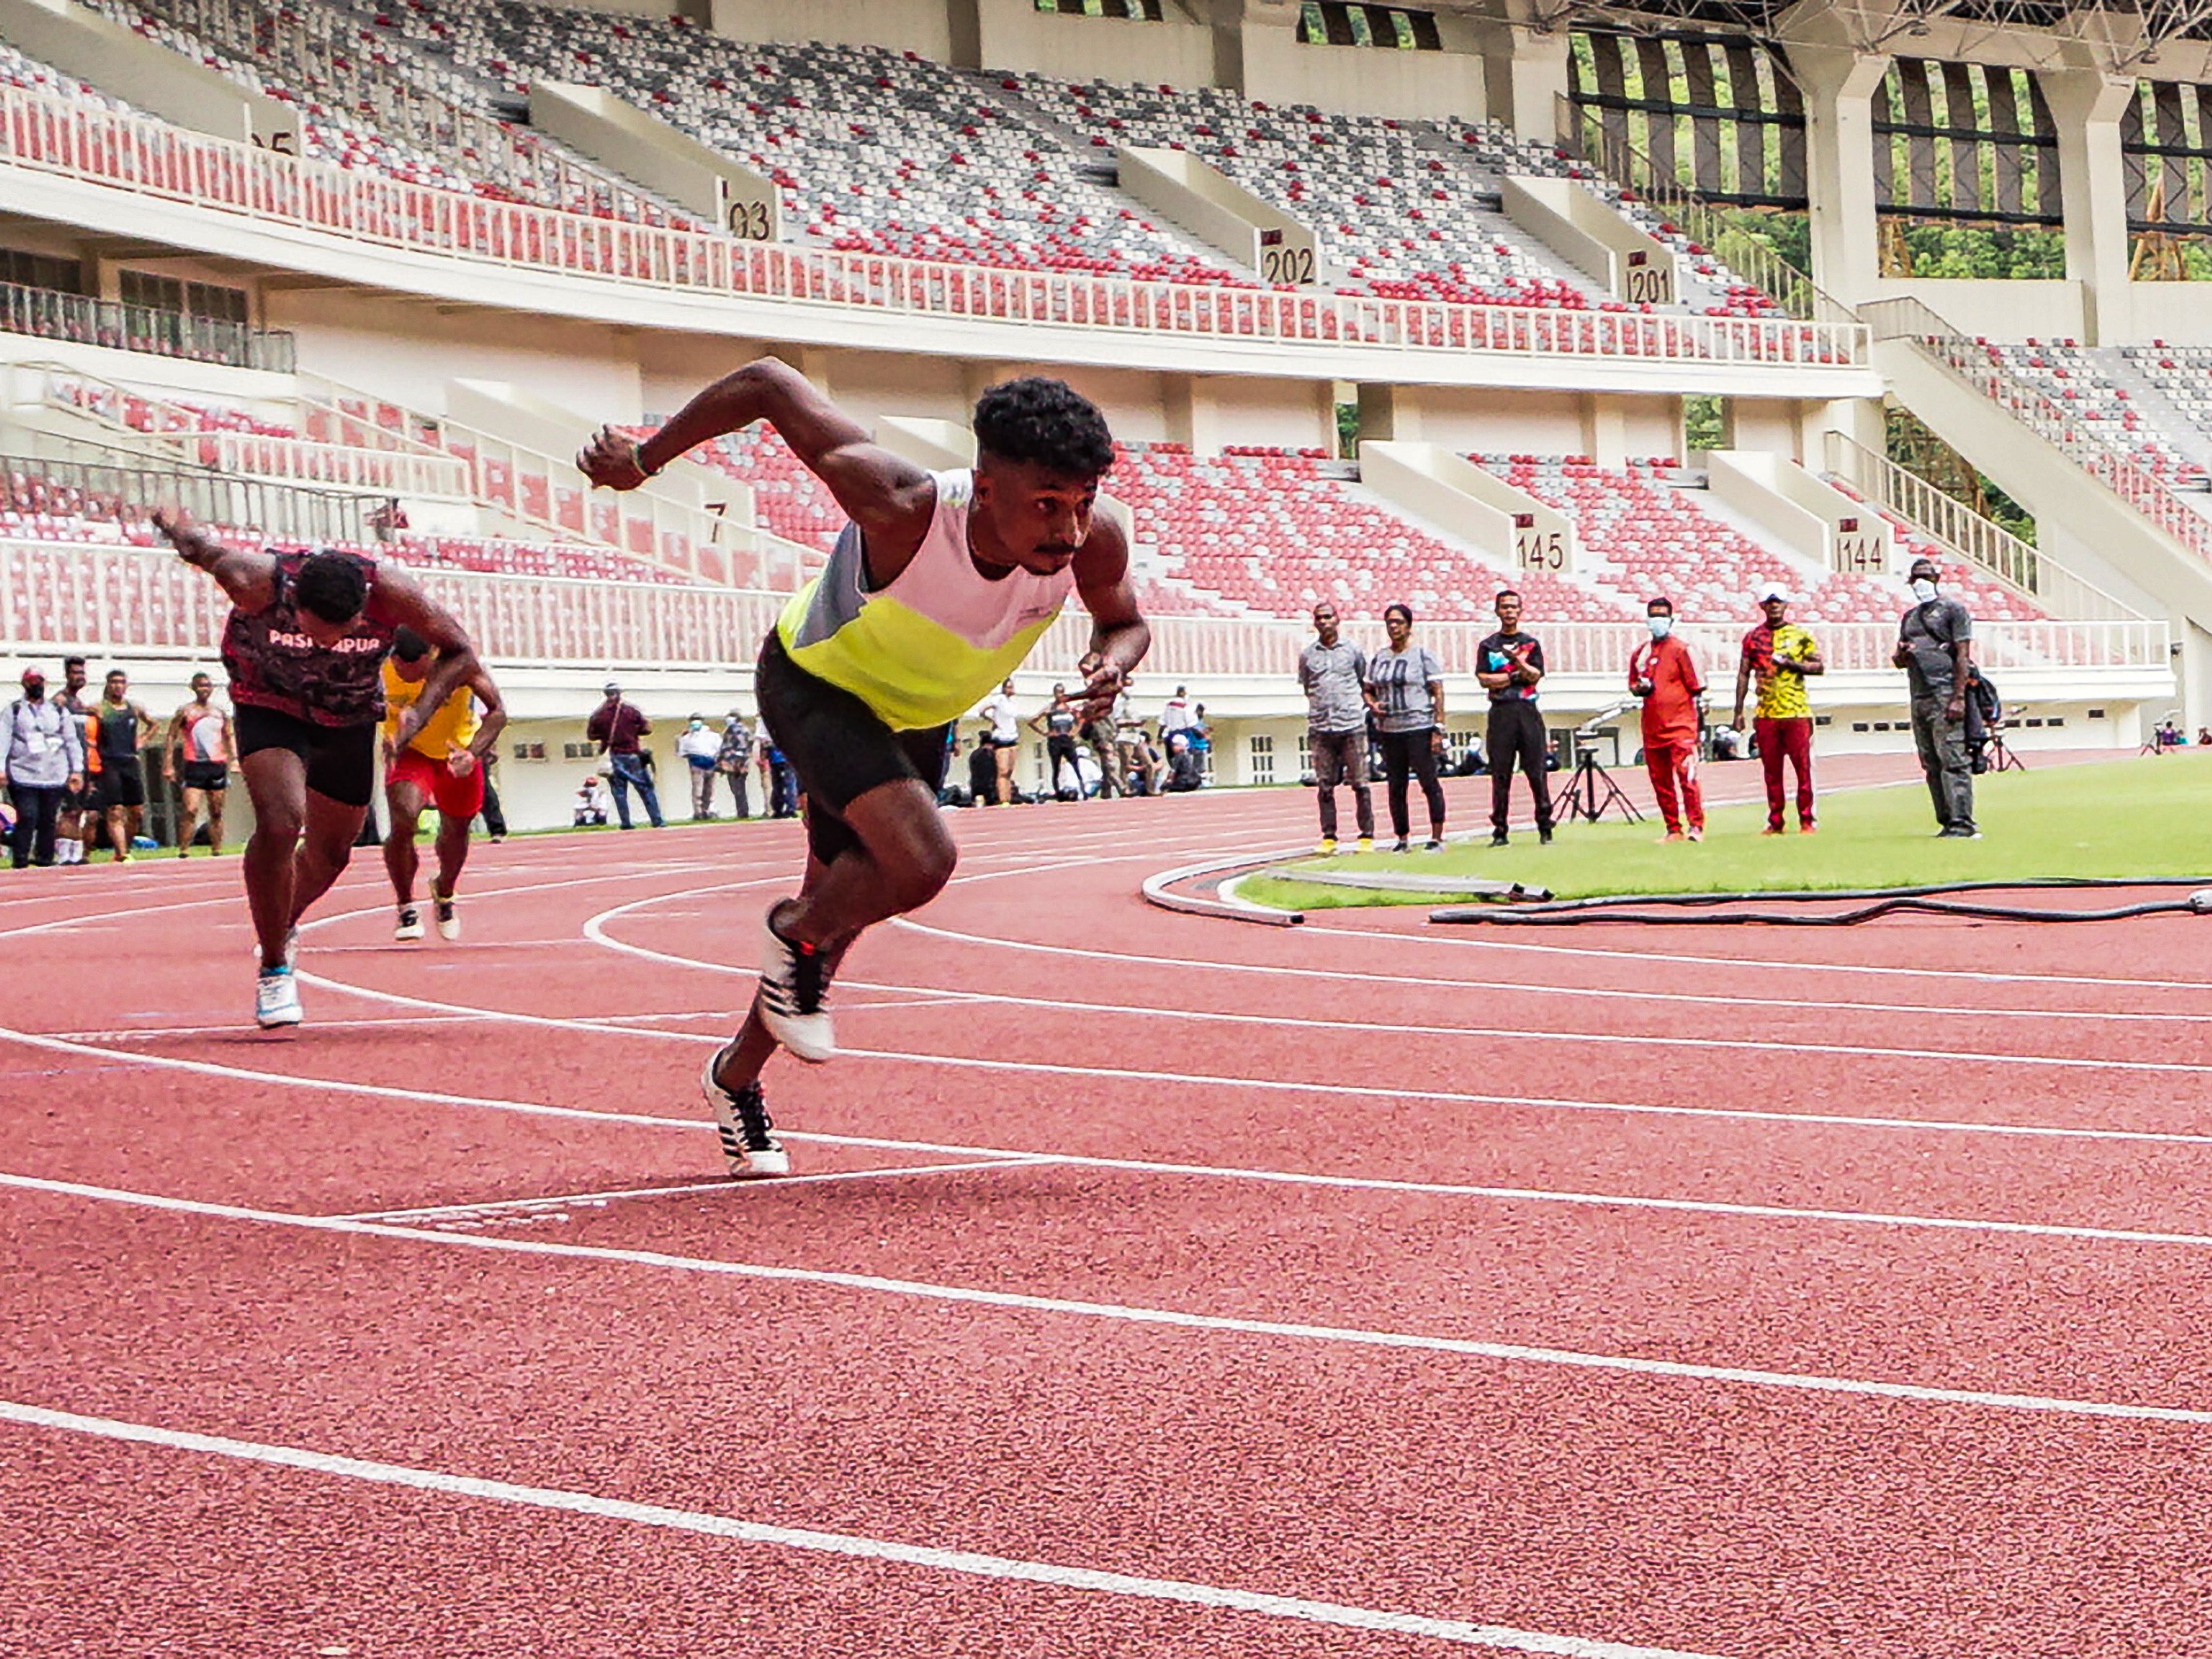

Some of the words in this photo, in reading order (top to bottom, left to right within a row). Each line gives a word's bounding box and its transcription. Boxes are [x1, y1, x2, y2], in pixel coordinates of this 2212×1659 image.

[1265, 248, 1314, 284] 202
[1517, 533, 1563, 570] 145
[269, 629, 313, 649] PASI
[319, 638, 381, 653] APUA
